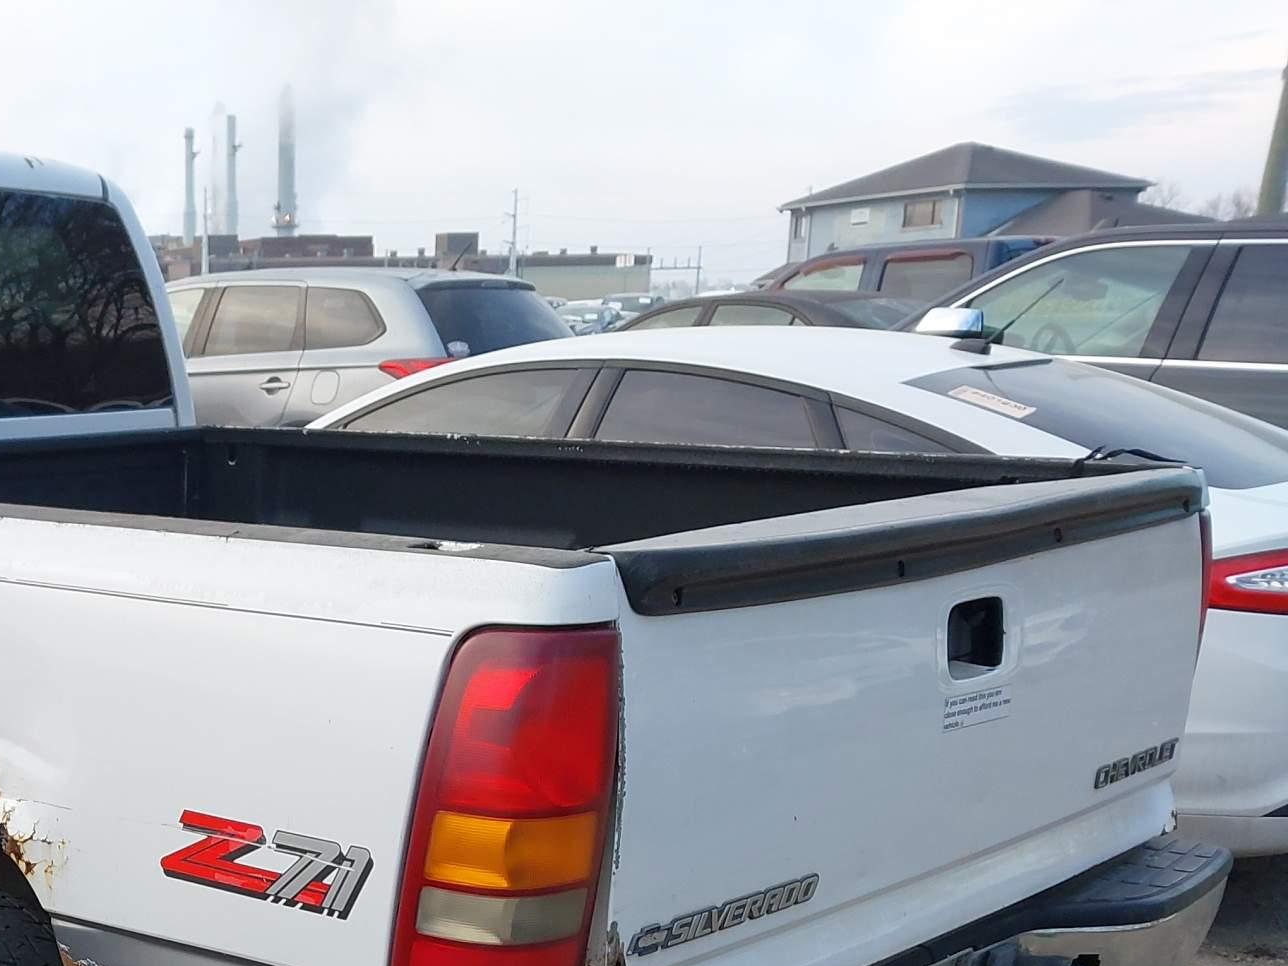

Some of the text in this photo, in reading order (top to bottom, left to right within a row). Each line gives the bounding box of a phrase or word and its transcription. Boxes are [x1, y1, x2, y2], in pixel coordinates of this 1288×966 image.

[1094, 737, 1179, 790] CHEVROLET
[160, 809, 374, 921] Z71
[665, 873, 820, 949] SILVERADO
